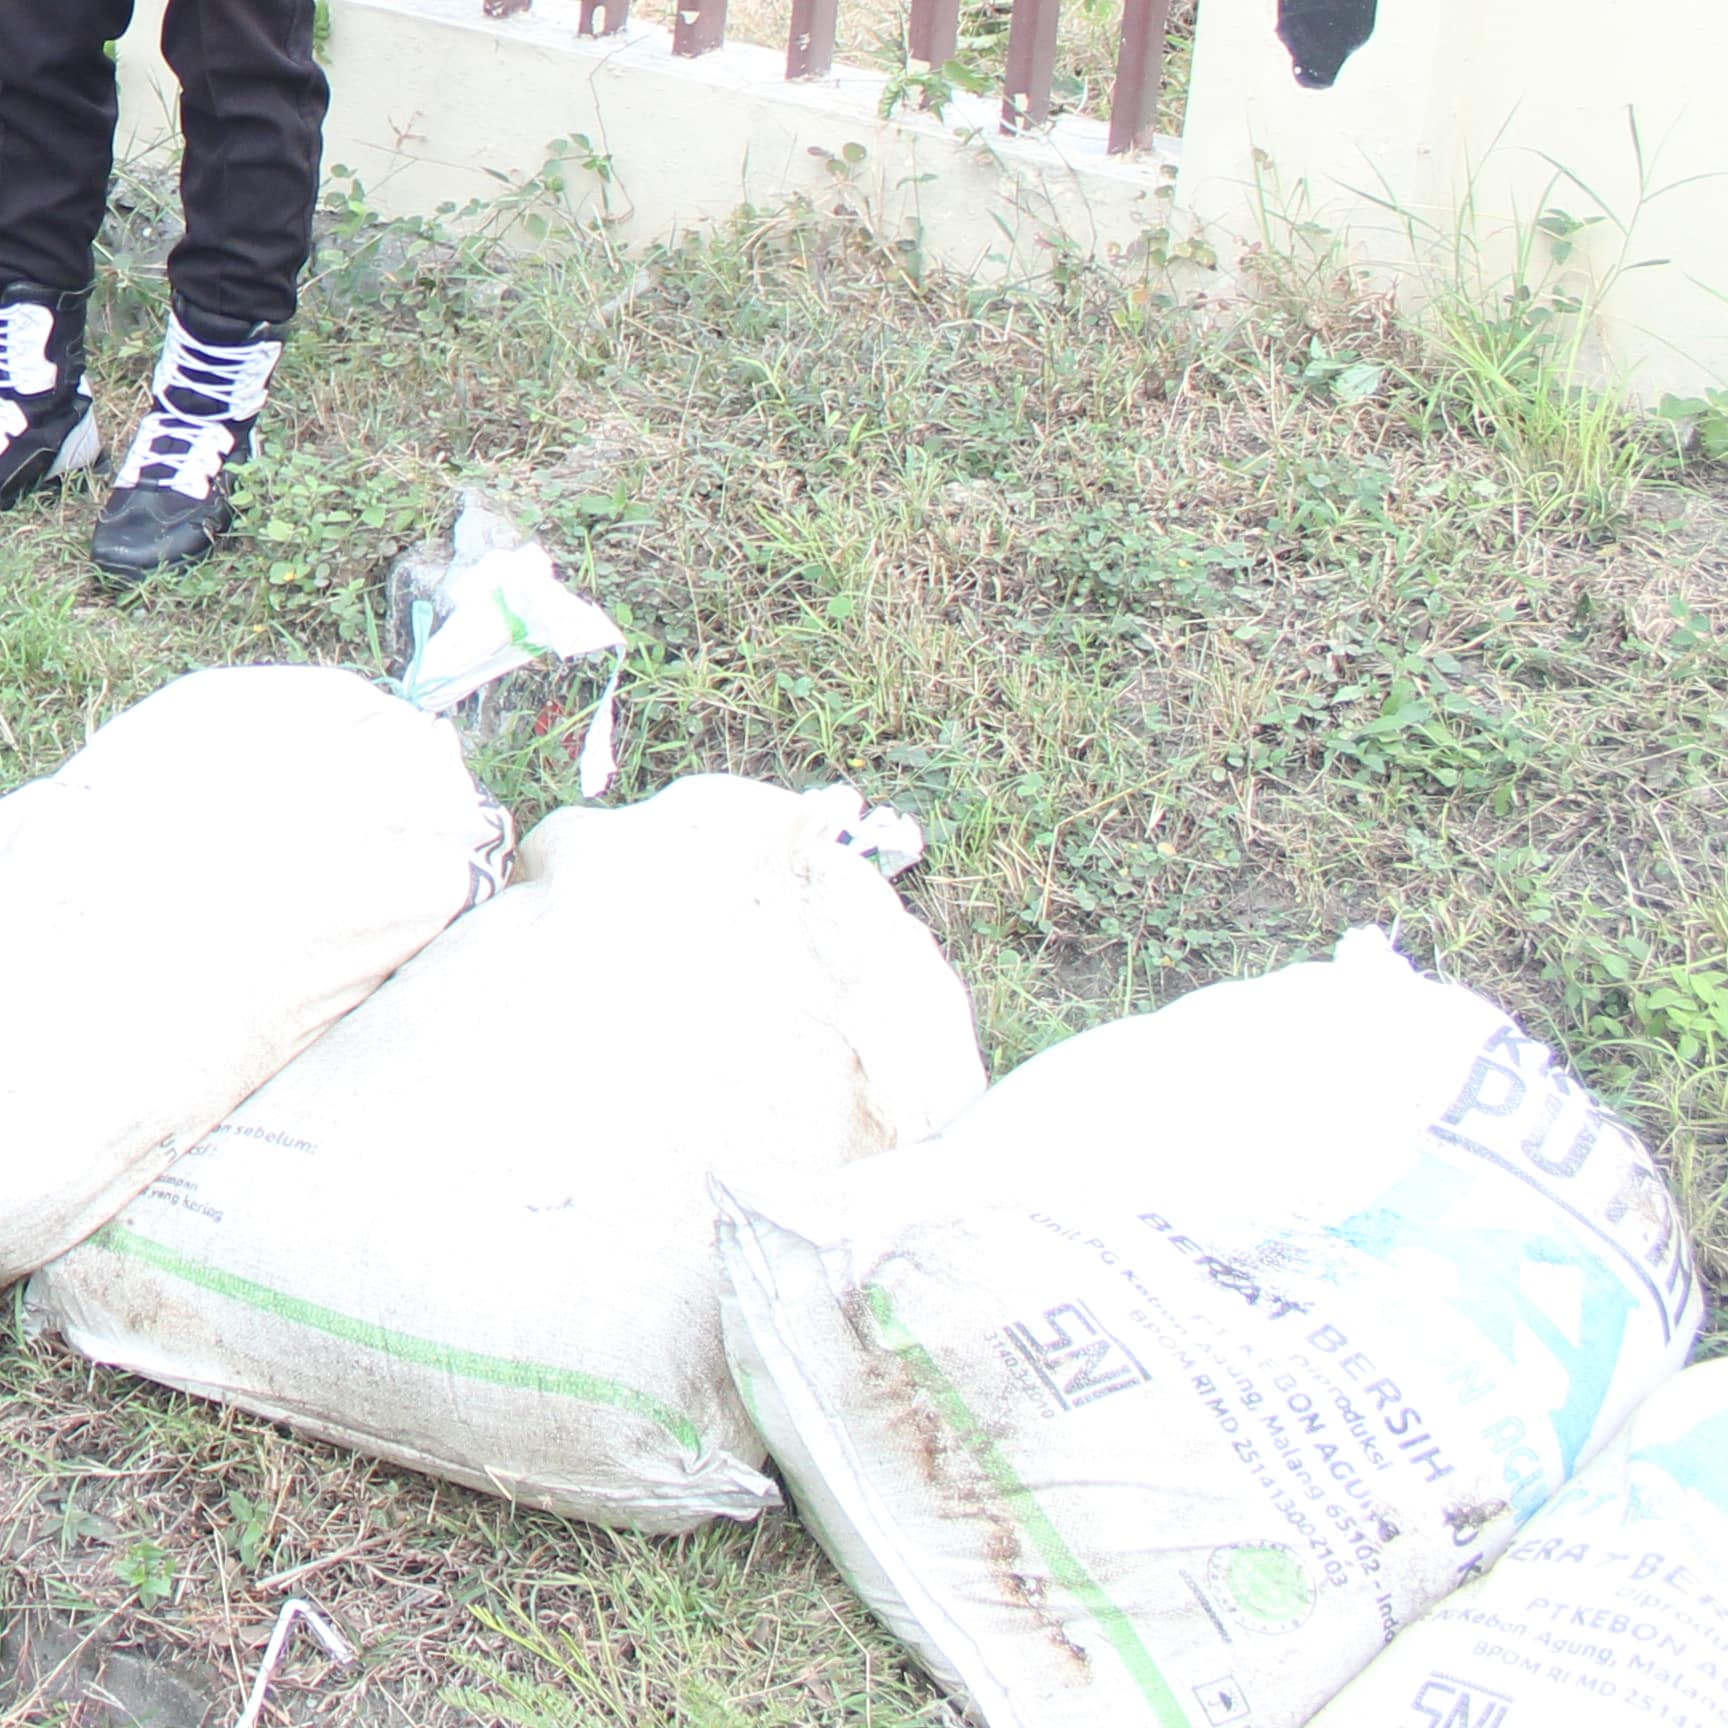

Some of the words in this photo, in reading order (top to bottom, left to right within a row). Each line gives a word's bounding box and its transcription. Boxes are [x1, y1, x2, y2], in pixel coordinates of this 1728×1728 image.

[234, 1124, 319, 1155] sebelum:
[149, 1187, 180, 1206] yang
[182, 1195, 224, 1224] kering
[1014, 1303, 1141, 1408] SNI
[1028, 1211, 1082, 1242] Unit
[1084, 1237, 1121, 1266] PG
[1259, 1413, 1325, 1500] Malang
[1325, 1502, 1382, 1578] 65162
[1127, 1308, 1197, 1377] BPOM
[1189, 1373, 1217, 1407] RI
[1204, 1396, 1242, 1435] MD
[1137, 1212, 1313, 1320] BERAT
[1305, 1322, 1455, 1484] BERSIH
[1237, 1343, 1328, 1435] KEBON
[1313, 1441, 1402, 1545] AGU
[1288, 1354, 1394, 1472] Diproduksi
[1457, 1607, 1528, 1637] Kebon
[1533, 1631, 1617, 1668] Agung,
[1472, 1640, 1542, 1674] BPOM
[1546, 1666, 1571, 1685] RI
[1575, 1673, 1617, 1697] MD
[1569, 1604, 1688, 1657] KEBON
